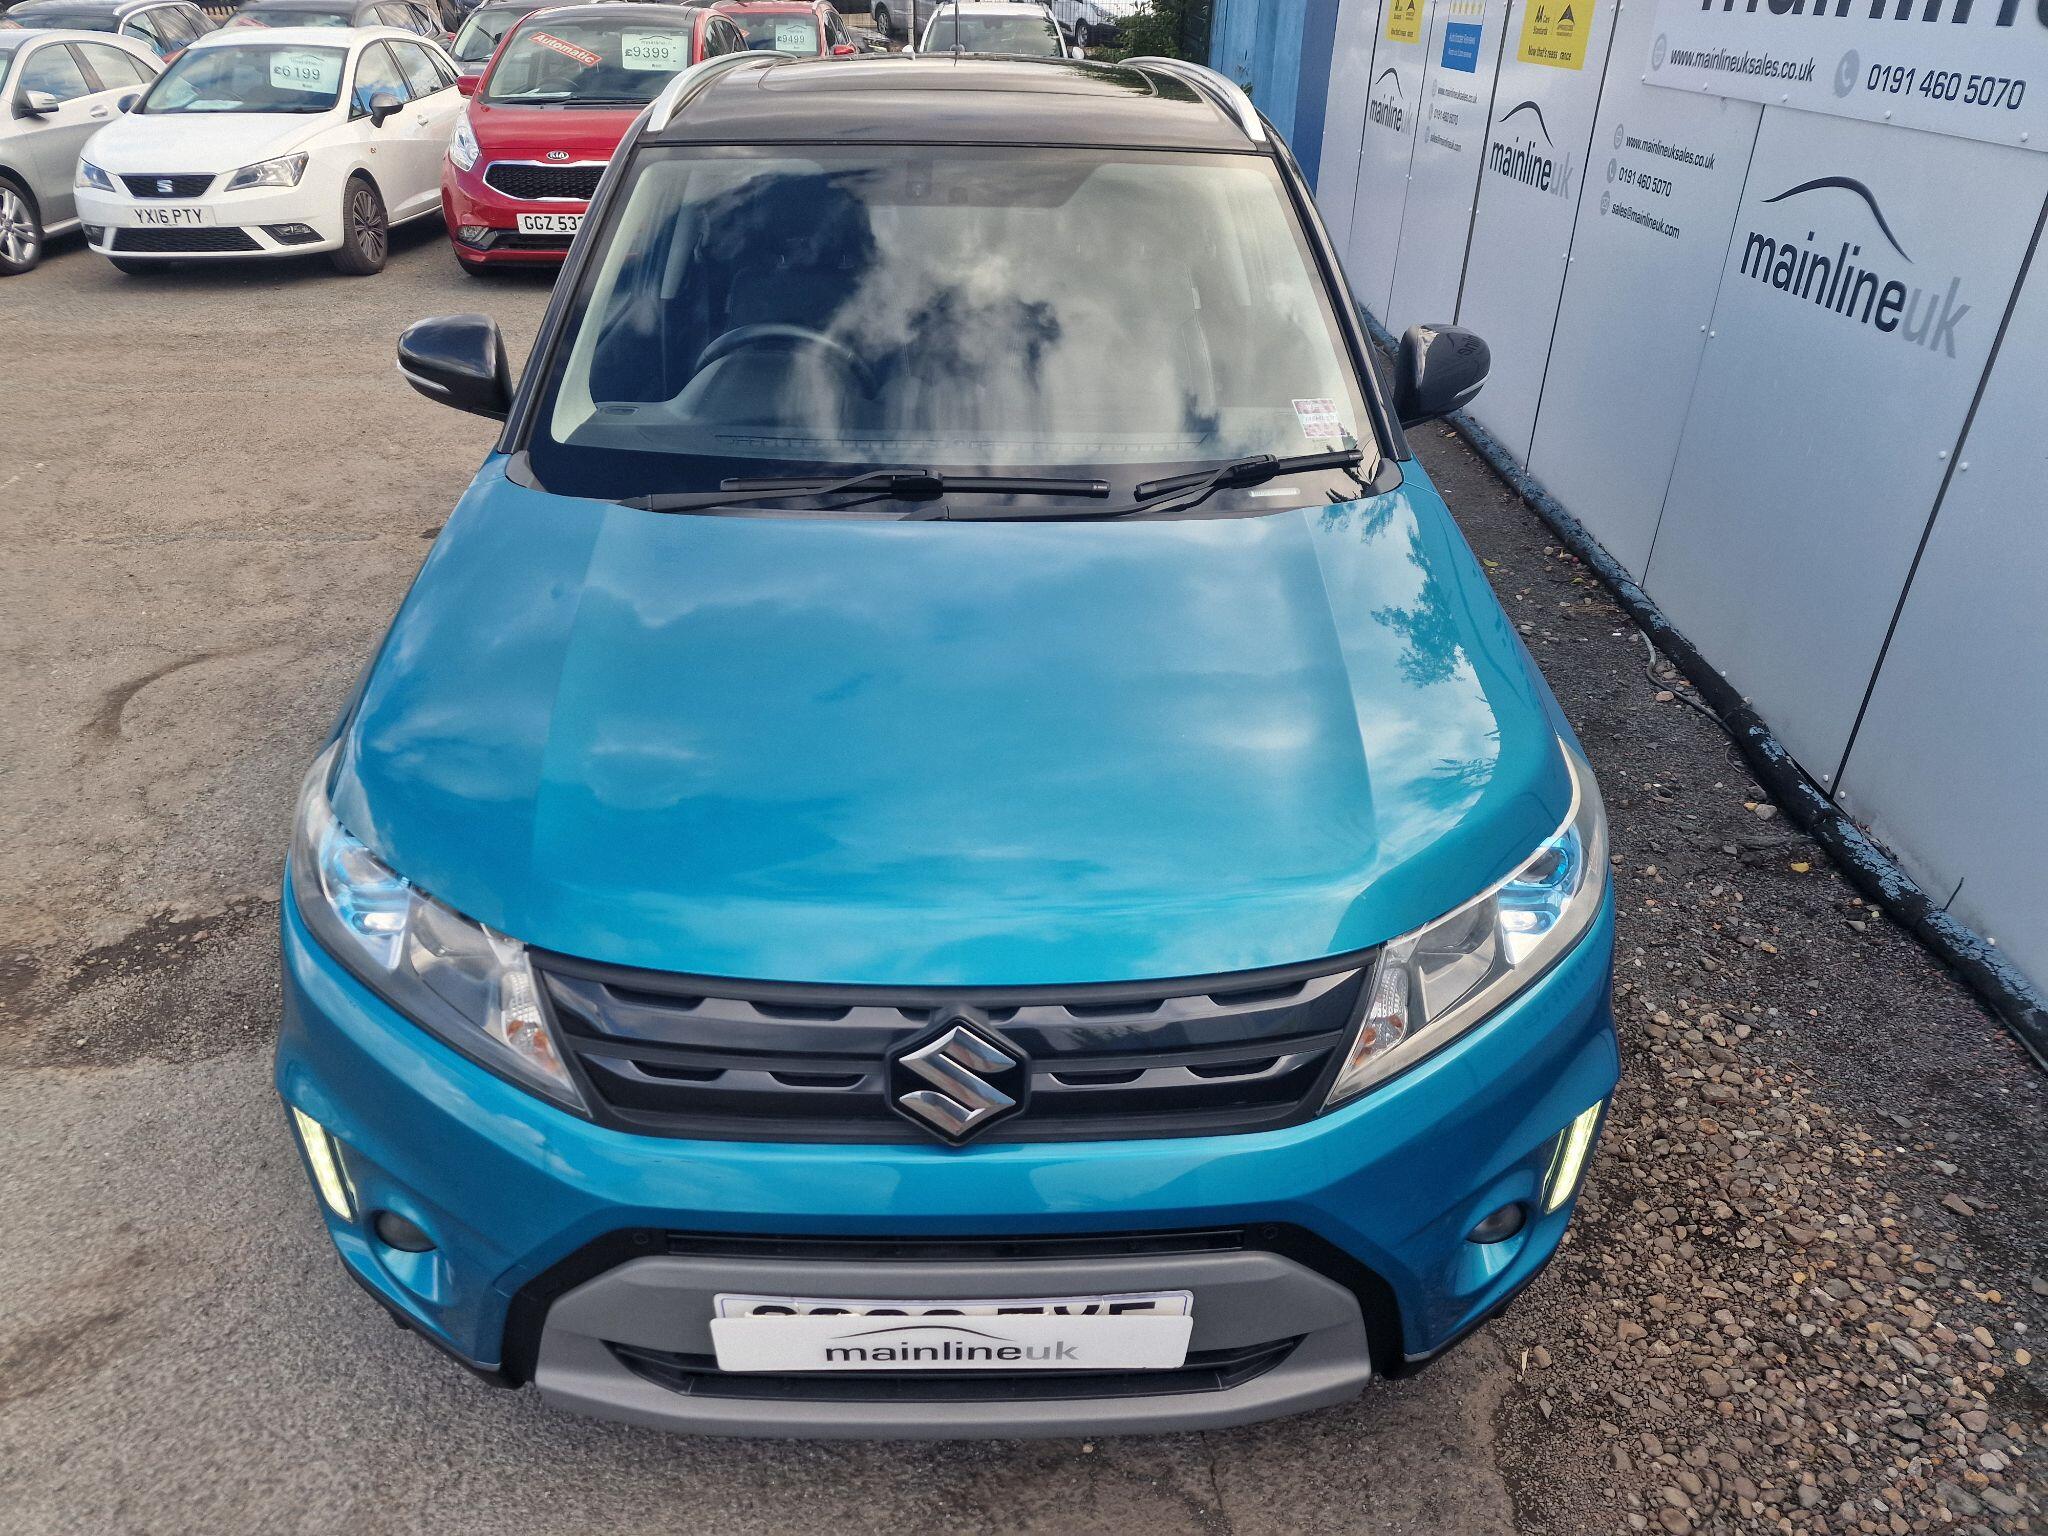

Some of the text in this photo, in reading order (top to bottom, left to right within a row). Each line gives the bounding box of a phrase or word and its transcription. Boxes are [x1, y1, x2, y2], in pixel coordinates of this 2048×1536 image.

[536, 33, 594, 64] Automatic
[624, 46, 669, 59] £9399
[1670, 48, 2027, 110] www.mainlineuksales.co.uk 0191 460 5070
[1625, 136, 1716, 170] www.mainlineuksales.co.uk
[1618, 166, 1673, 197] 0191 460 5070
[134, 209, 202, 224] YX16 PTY
[524, 216, 584, 231] GGZ 53
[1611, 201, 1680, 239] sales@mainlineuk.com
[825, 1340, 1081, 1363] mainlineuk
